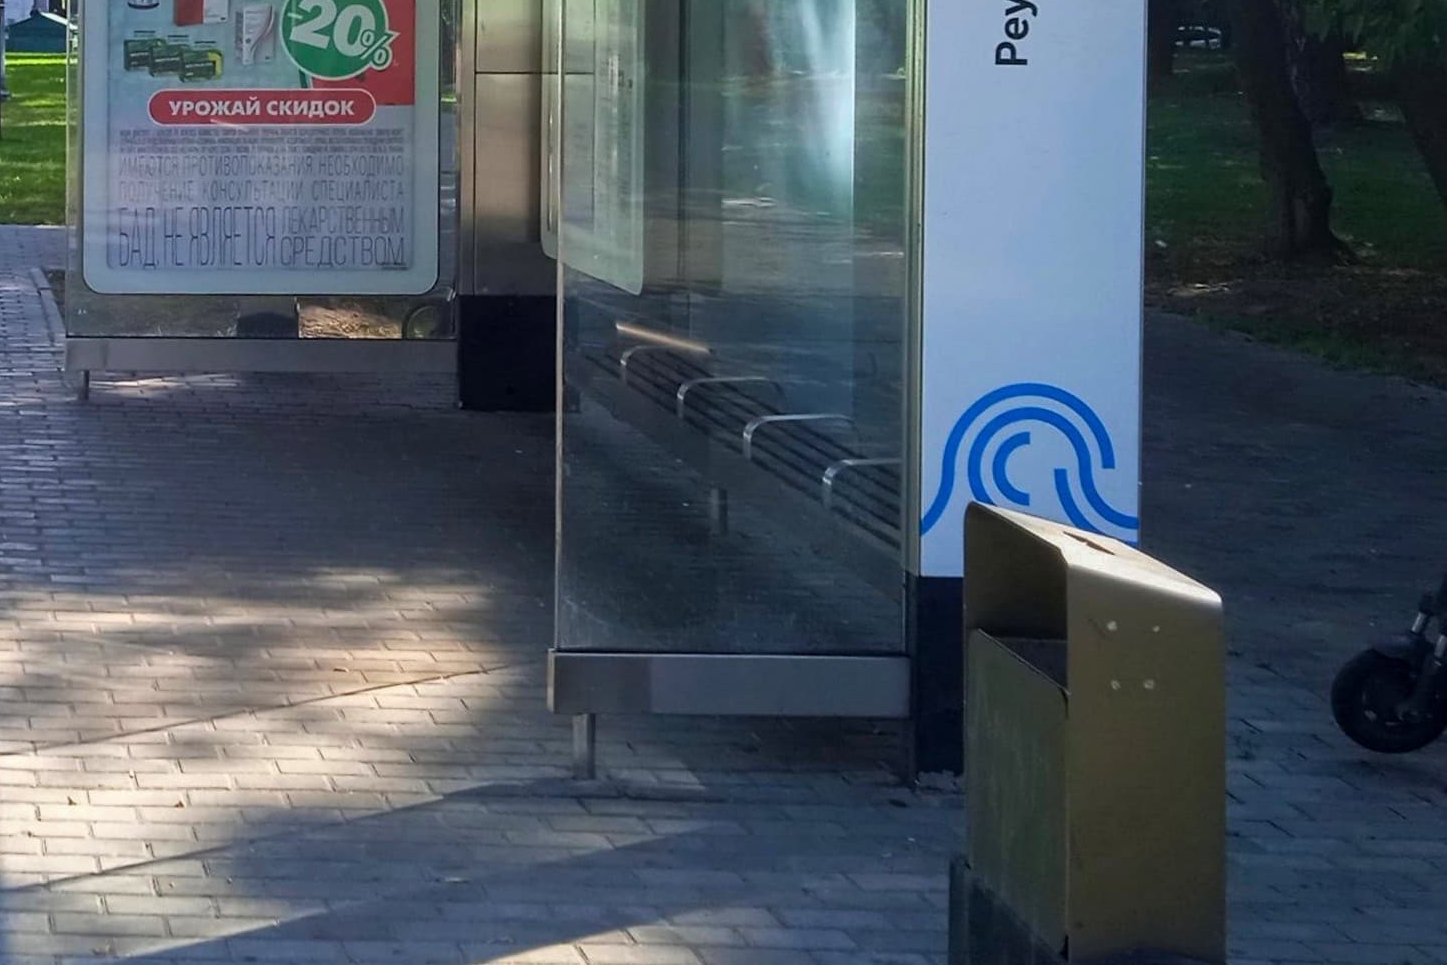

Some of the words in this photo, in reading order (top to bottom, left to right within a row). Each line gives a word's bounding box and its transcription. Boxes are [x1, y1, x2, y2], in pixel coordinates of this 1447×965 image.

[169, 96, 261, 116] УРОЖАЙ
[266, 100, 355, 116] СКИДОК
[319, 155, 404, 178] НЕОБХОДИМО
[311, 180, 404, 202] СПЕЦИАЛИСТА
[281, 205, 404, 234] ЛЕКАРСТВЕННЫМ
[164, 206, 184, 266] НЕ
[189, 206, 277, 266] ЯВЛЯЕТСЯ
[280, 236, 405, 269] СРЕДСТВОМ
